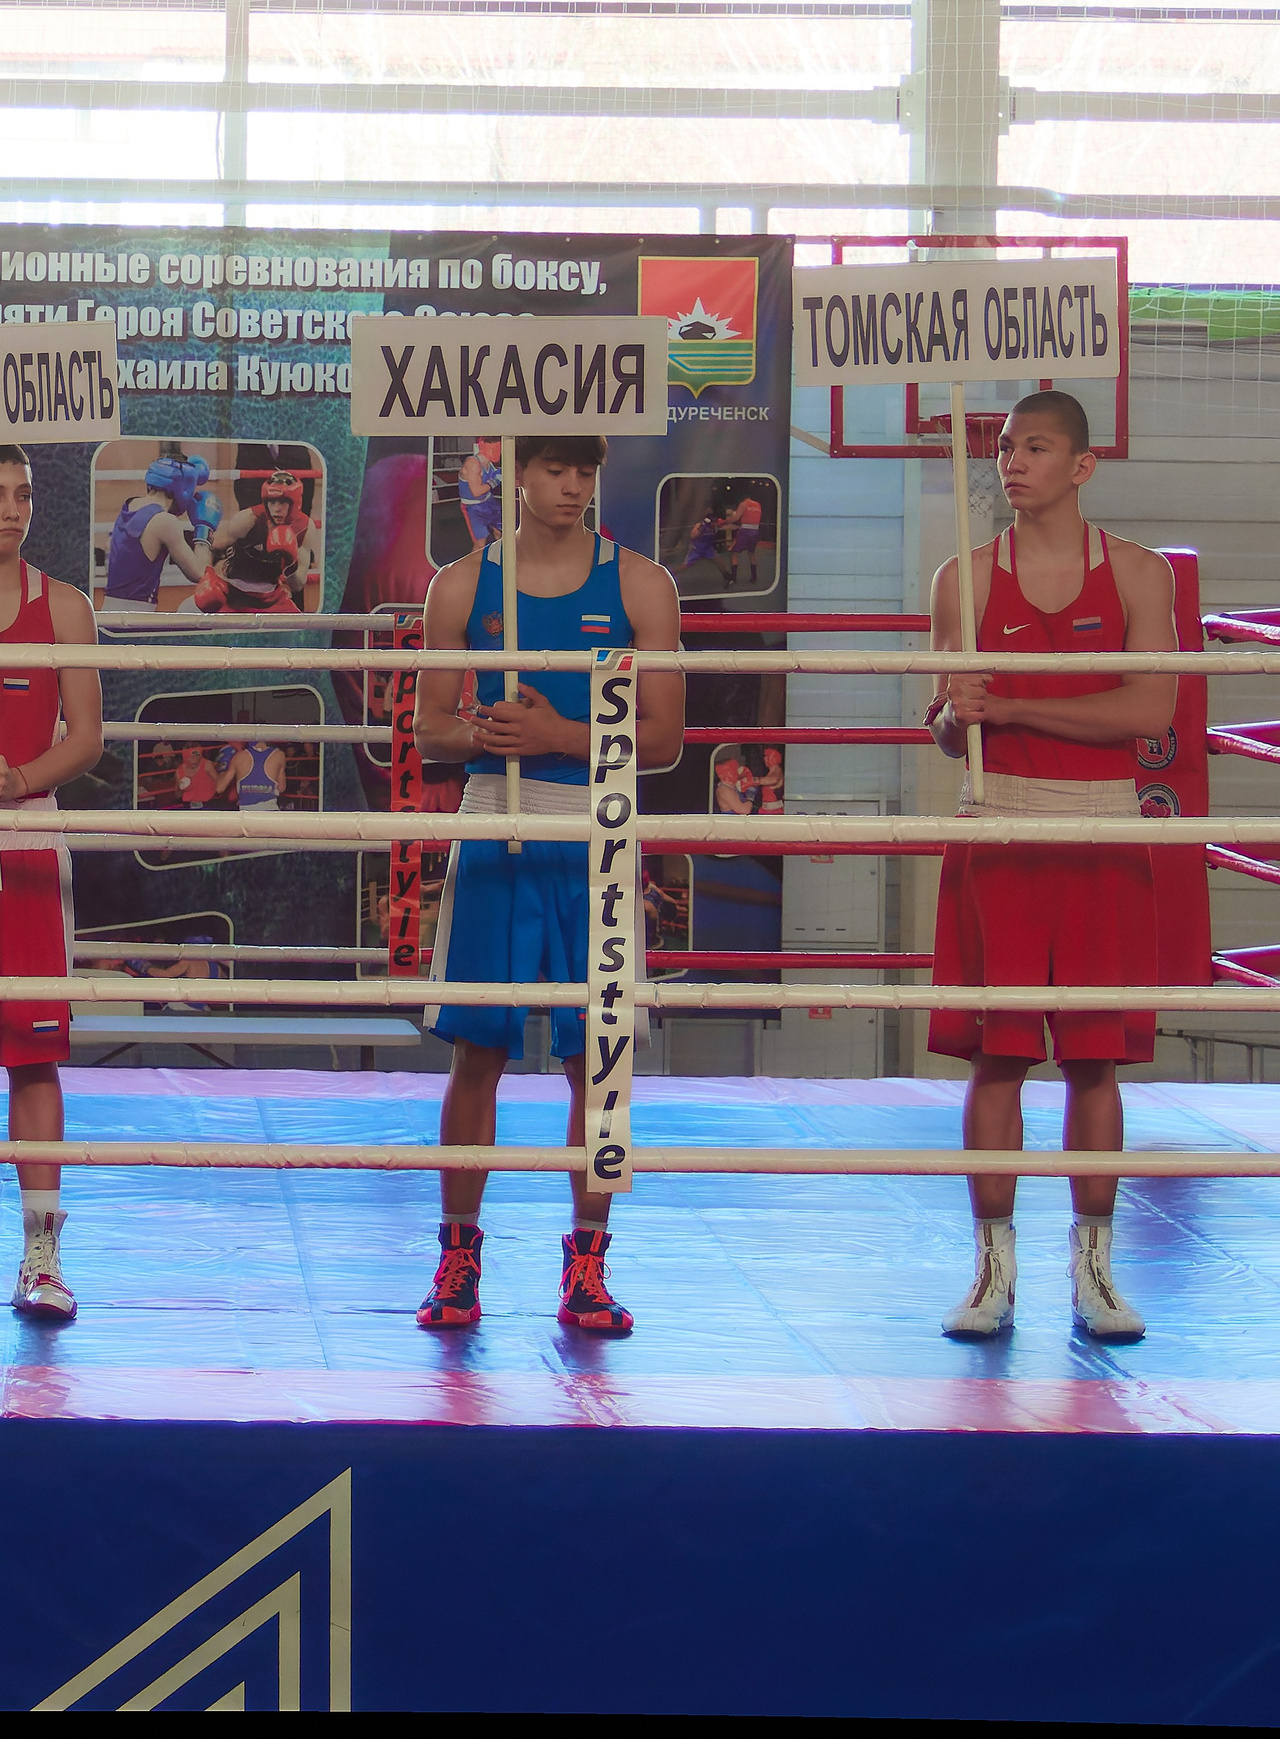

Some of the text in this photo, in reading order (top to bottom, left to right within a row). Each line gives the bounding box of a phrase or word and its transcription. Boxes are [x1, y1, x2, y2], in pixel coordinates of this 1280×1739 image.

[159, 252, 430, 289] соревнования
[438, 258, 483, 290] по
[491, 253, 608, 296] боксу,
[192, 301, 405, 340] Советск
[802, 284, 1108, 367] ТОМСКАЯ ОБЛАСТЬ
[3, 350, 115, 425] ОБЛАСТЬ
[116, 355, 353, 396] хаила Куюко
[378, 343, 646, 418] ХАКАСИЯ
[667, 406, 770, 423] ДУРЕЧЕНСК
[592, 677, 634, 1179] Sportstyle
